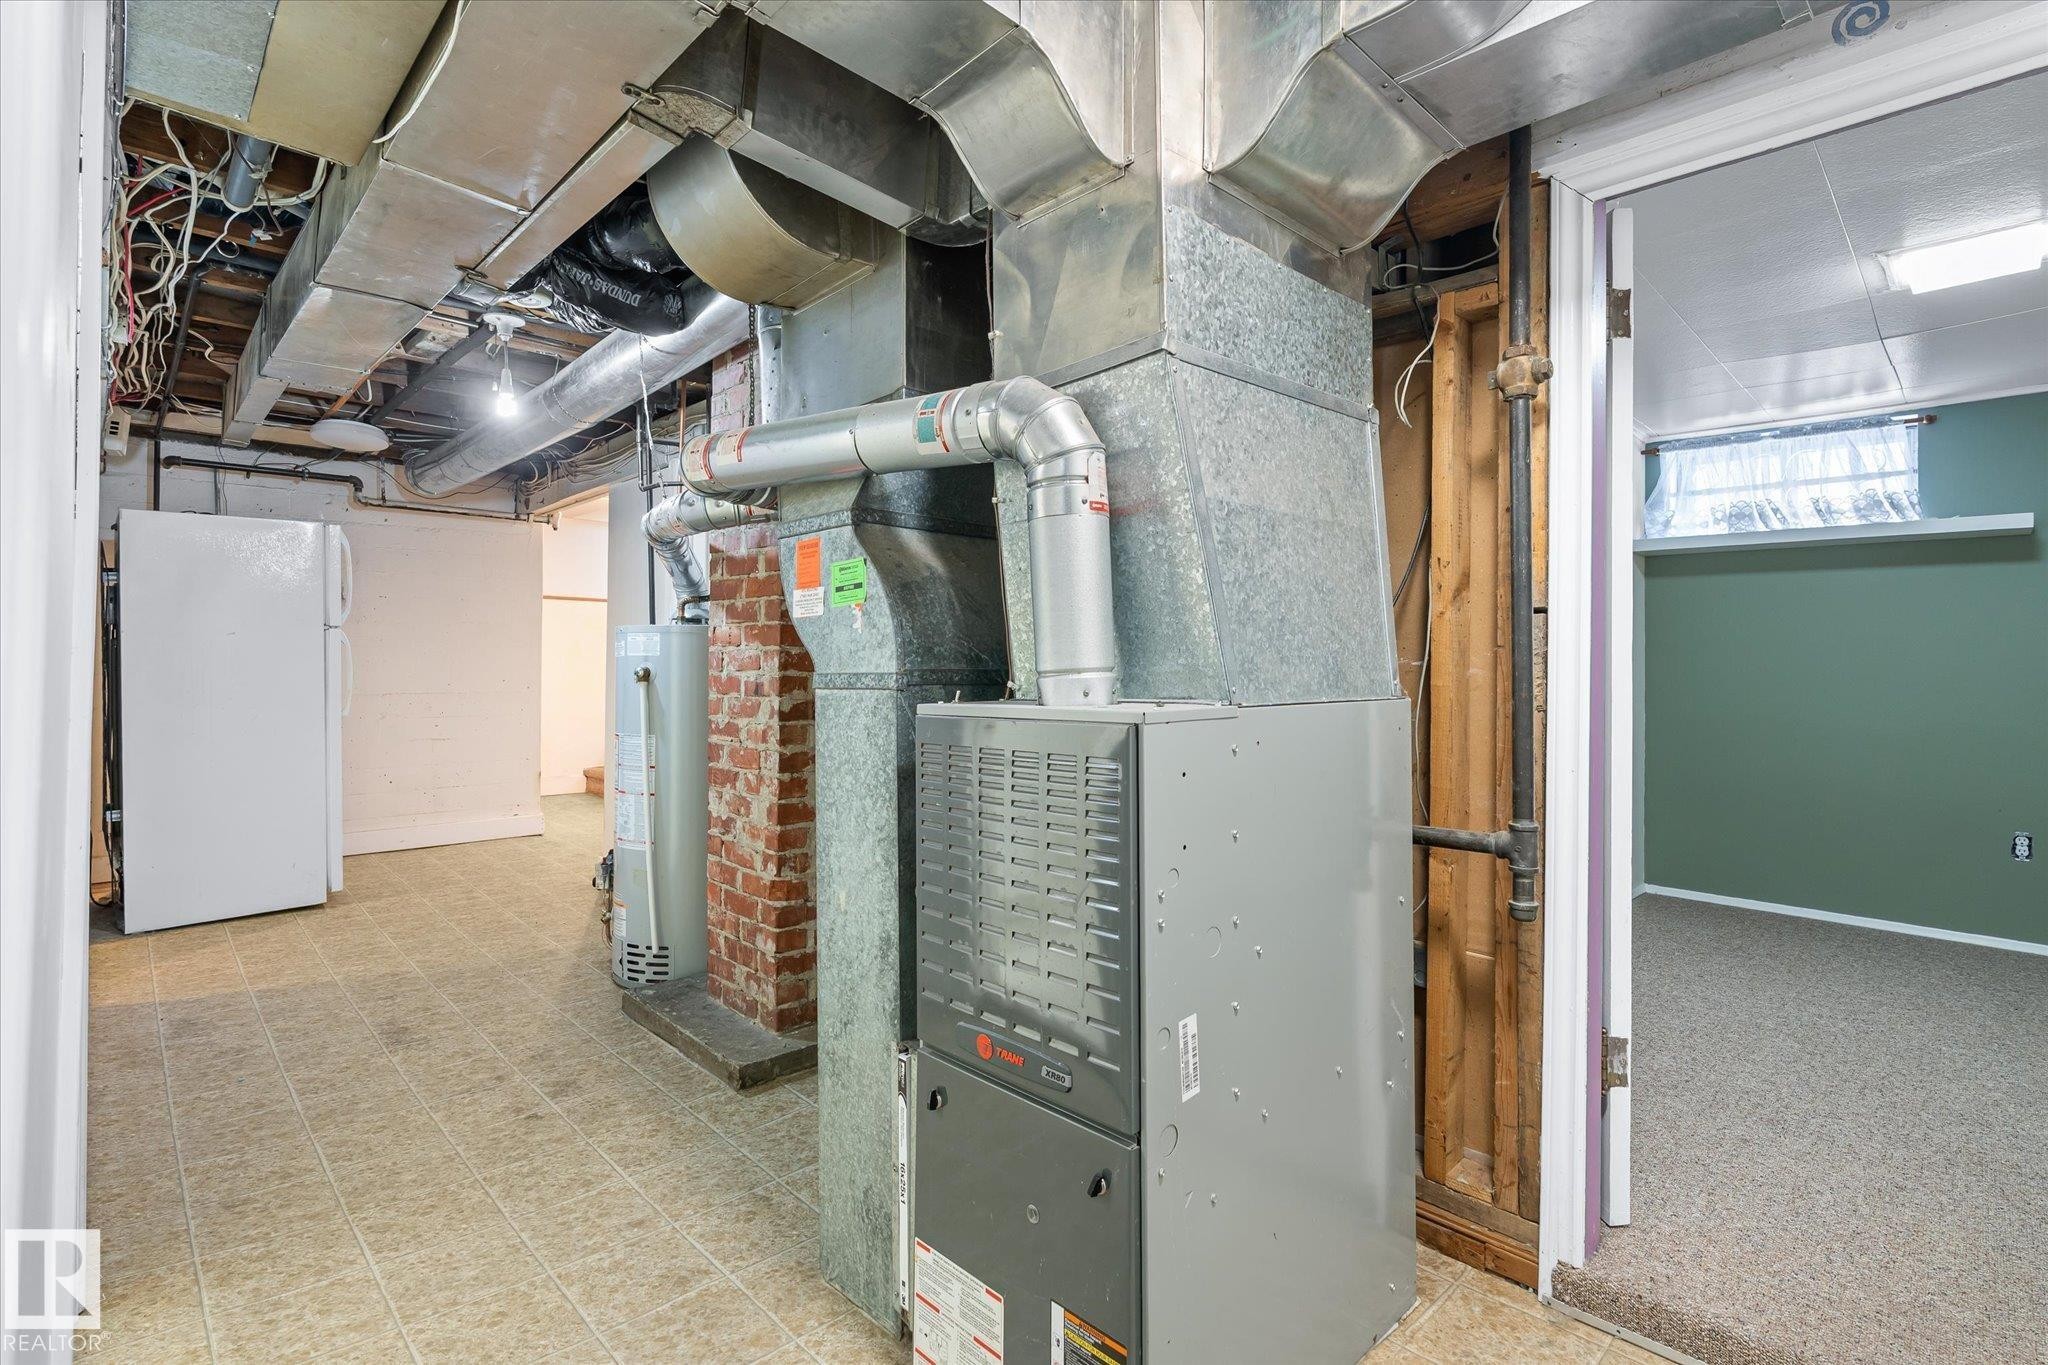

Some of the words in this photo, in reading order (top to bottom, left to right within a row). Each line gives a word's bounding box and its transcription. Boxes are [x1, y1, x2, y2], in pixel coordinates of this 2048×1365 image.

[593, 278, 642, 307] DUNDAS
[996, 1046, 1025, 1067] TRANE
[1045, 1068, 1066, 1084] XR80
